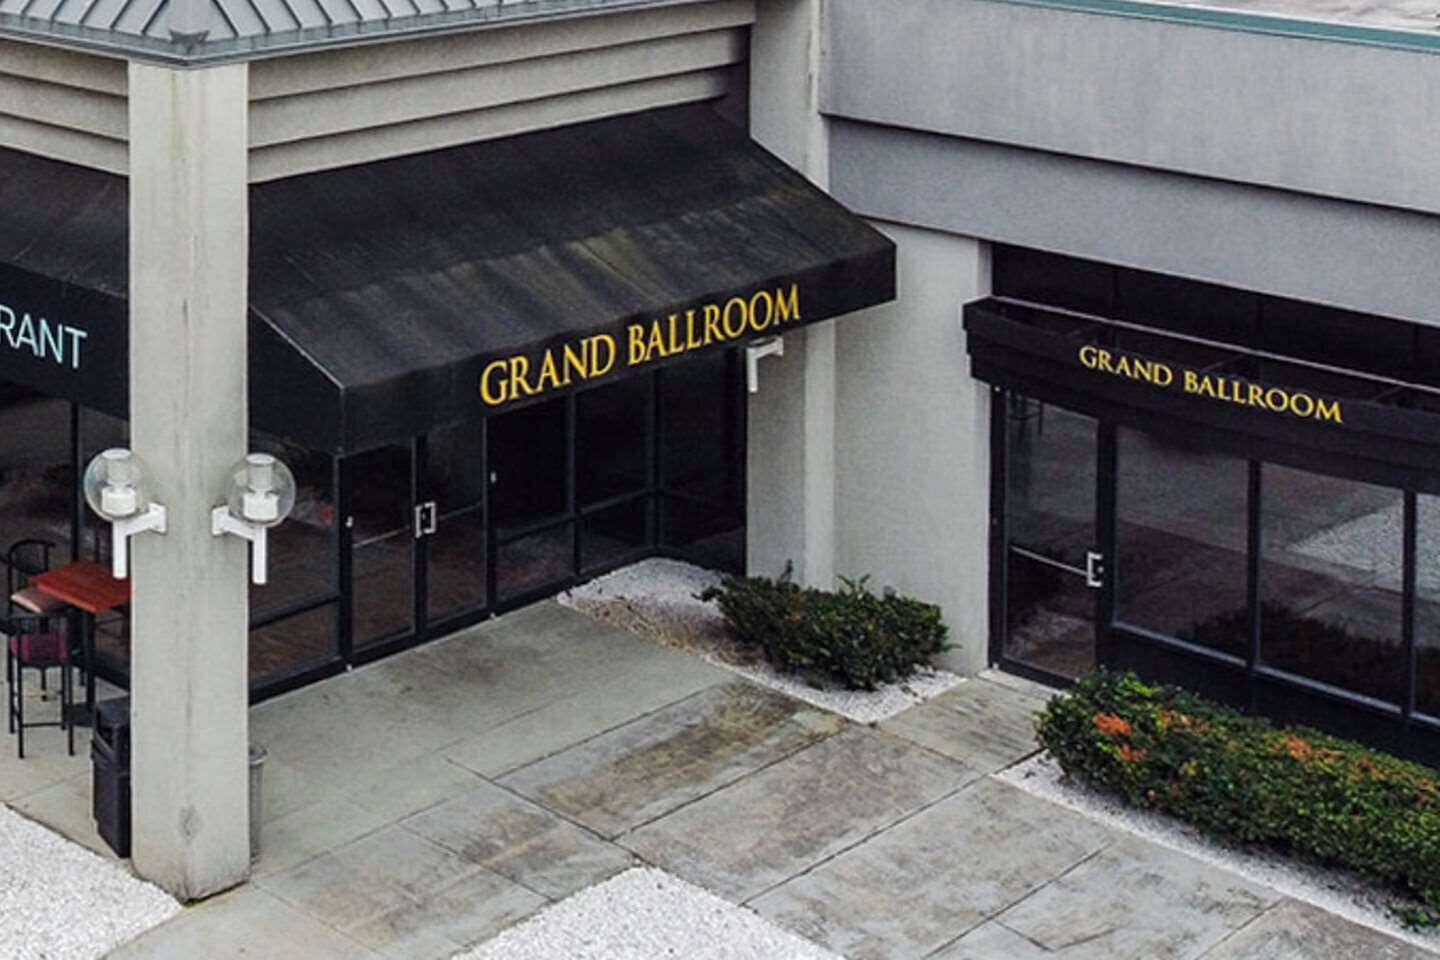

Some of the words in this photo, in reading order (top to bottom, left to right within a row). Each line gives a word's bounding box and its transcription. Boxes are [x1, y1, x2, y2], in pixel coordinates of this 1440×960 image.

[480, 333, 616, 405] GRAND
[627, 283, 801, 366] BALLROOM
[1079, 345, 1173, 387] GRAND
[1183, 370, 1344, 424] BALLROOM
